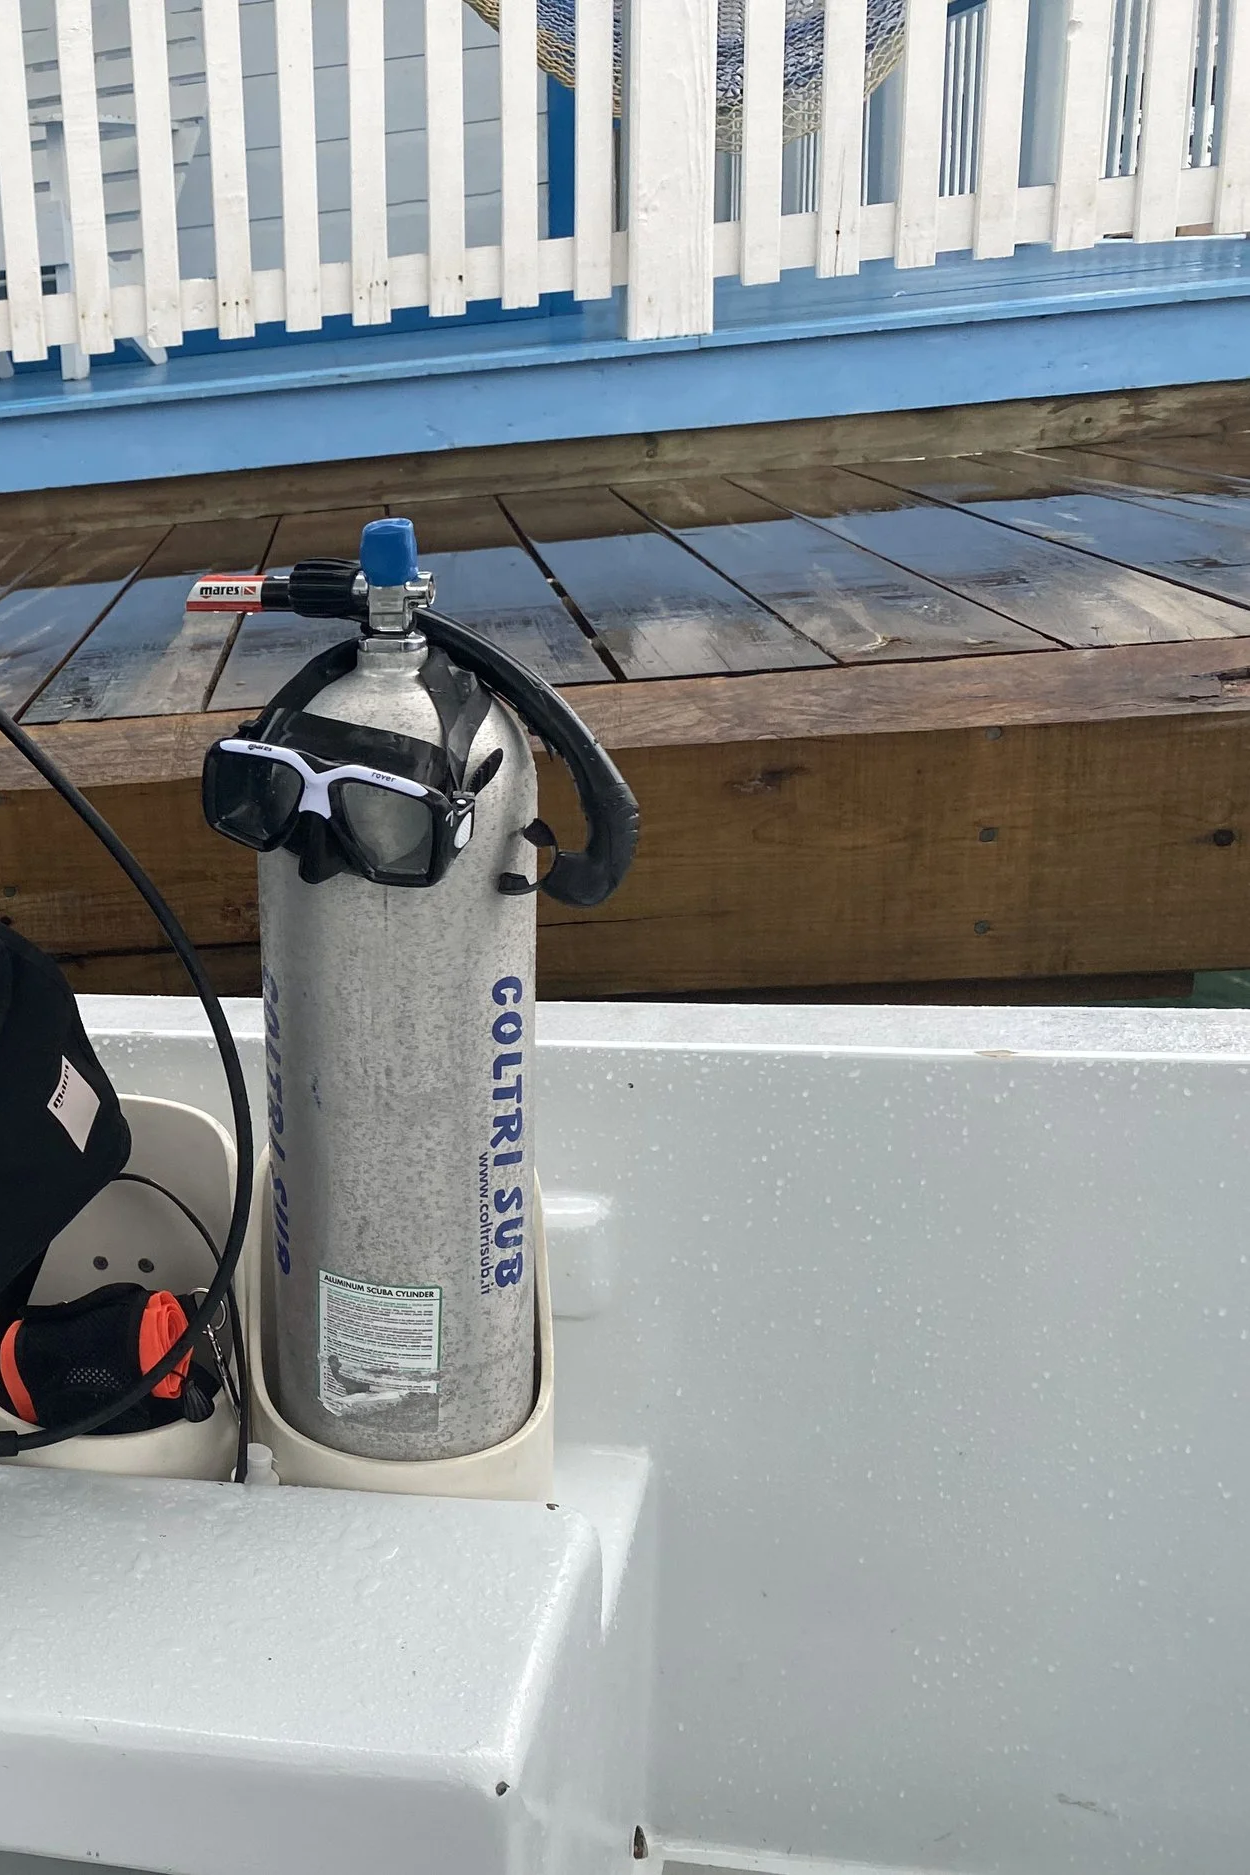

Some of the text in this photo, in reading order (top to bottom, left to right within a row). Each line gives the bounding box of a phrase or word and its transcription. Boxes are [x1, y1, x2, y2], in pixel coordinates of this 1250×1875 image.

[200, 586, 239, 596] mares
[371, 771, 397, 783] rover
[490, 975, 523, 1288] COLTRI SUB
[478, 1152, 494, 1295] www.coltrisub.it
[324, 1274, 435, 1298] ALUMINUM SCUBA CYLINDER
